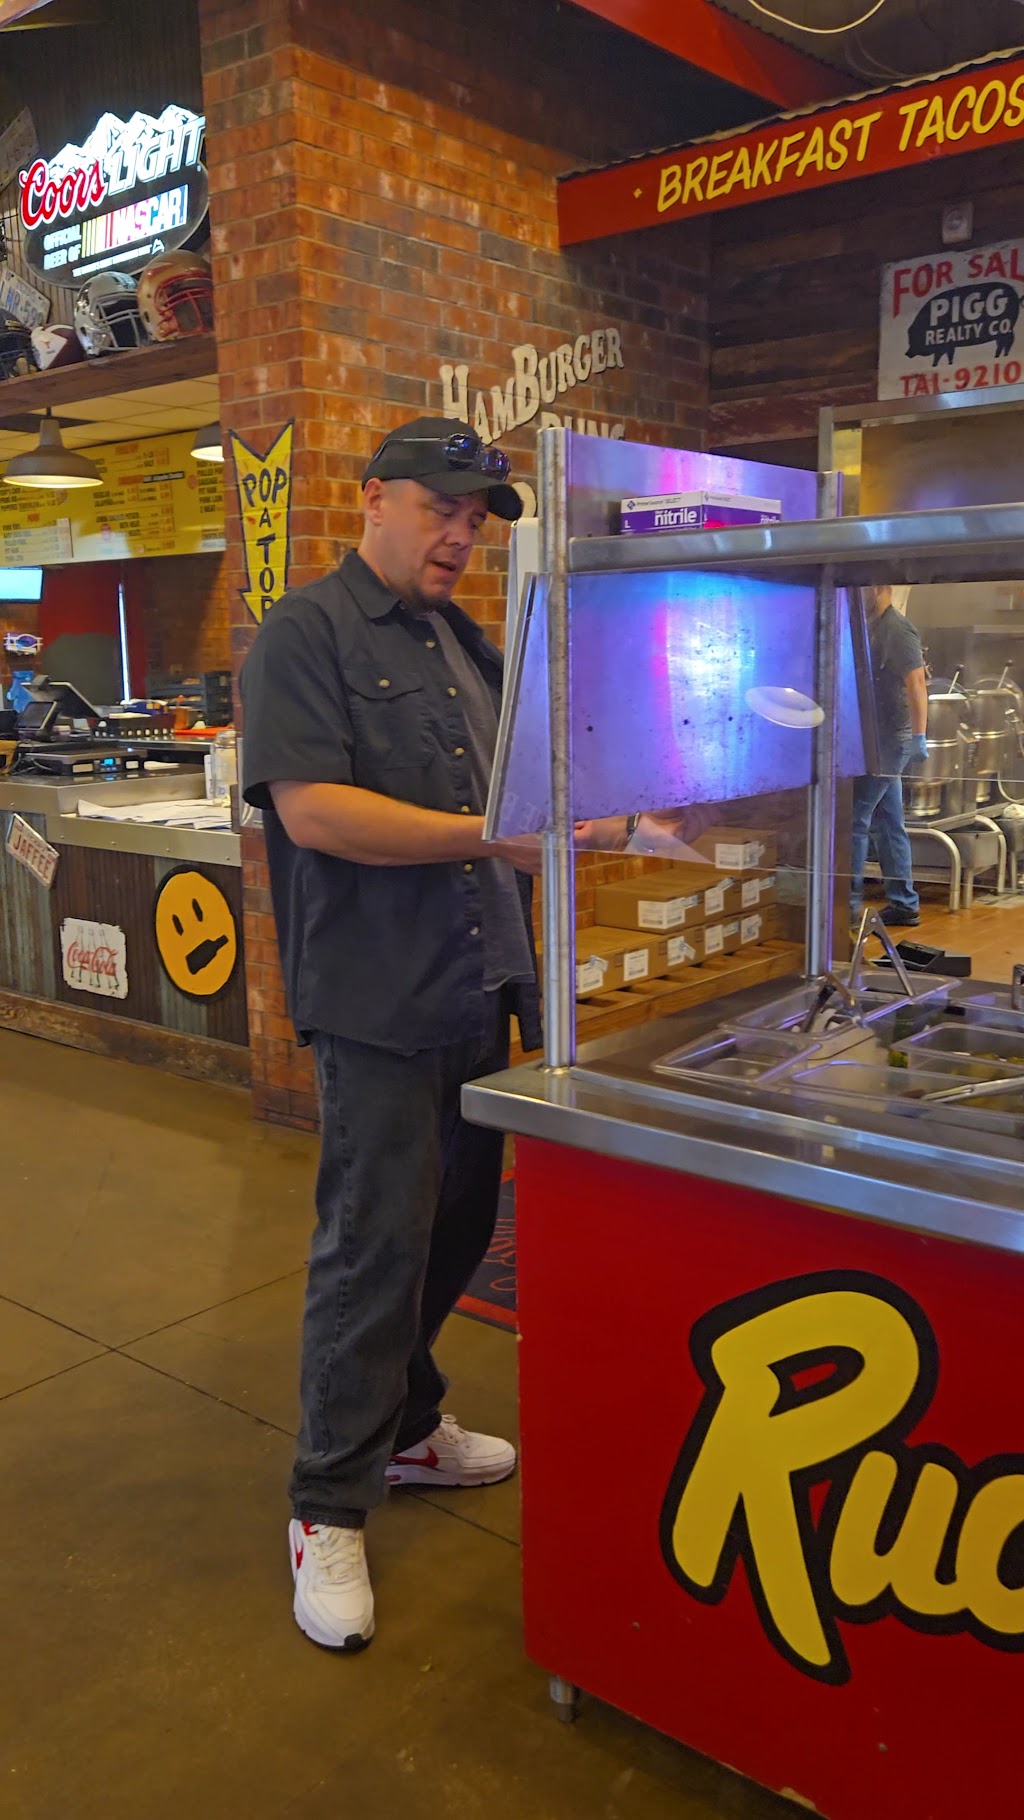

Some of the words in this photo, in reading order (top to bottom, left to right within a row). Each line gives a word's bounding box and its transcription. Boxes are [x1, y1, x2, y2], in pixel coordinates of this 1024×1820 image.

[657, 111, 884, 213] BREAKFAST
[899, 80, 1024, 152] TACOS
[20, 159, 105, 229] Coors
[106, 116, 206, 197] LIGHT
[112, 186, 185, 246] NASCAR
[893, 261, 953, 319] FOR
[930, 289, 1008, 326] PIGG
[926, 324, 984, 346] REALTY
[989, 319, 1013, 336] CO.
[241, 467, 287, 507] POP
[258, 507, 271, 528] A
[624, 519, 631, 528] L
[654, 508, 697, 526] nitrile
